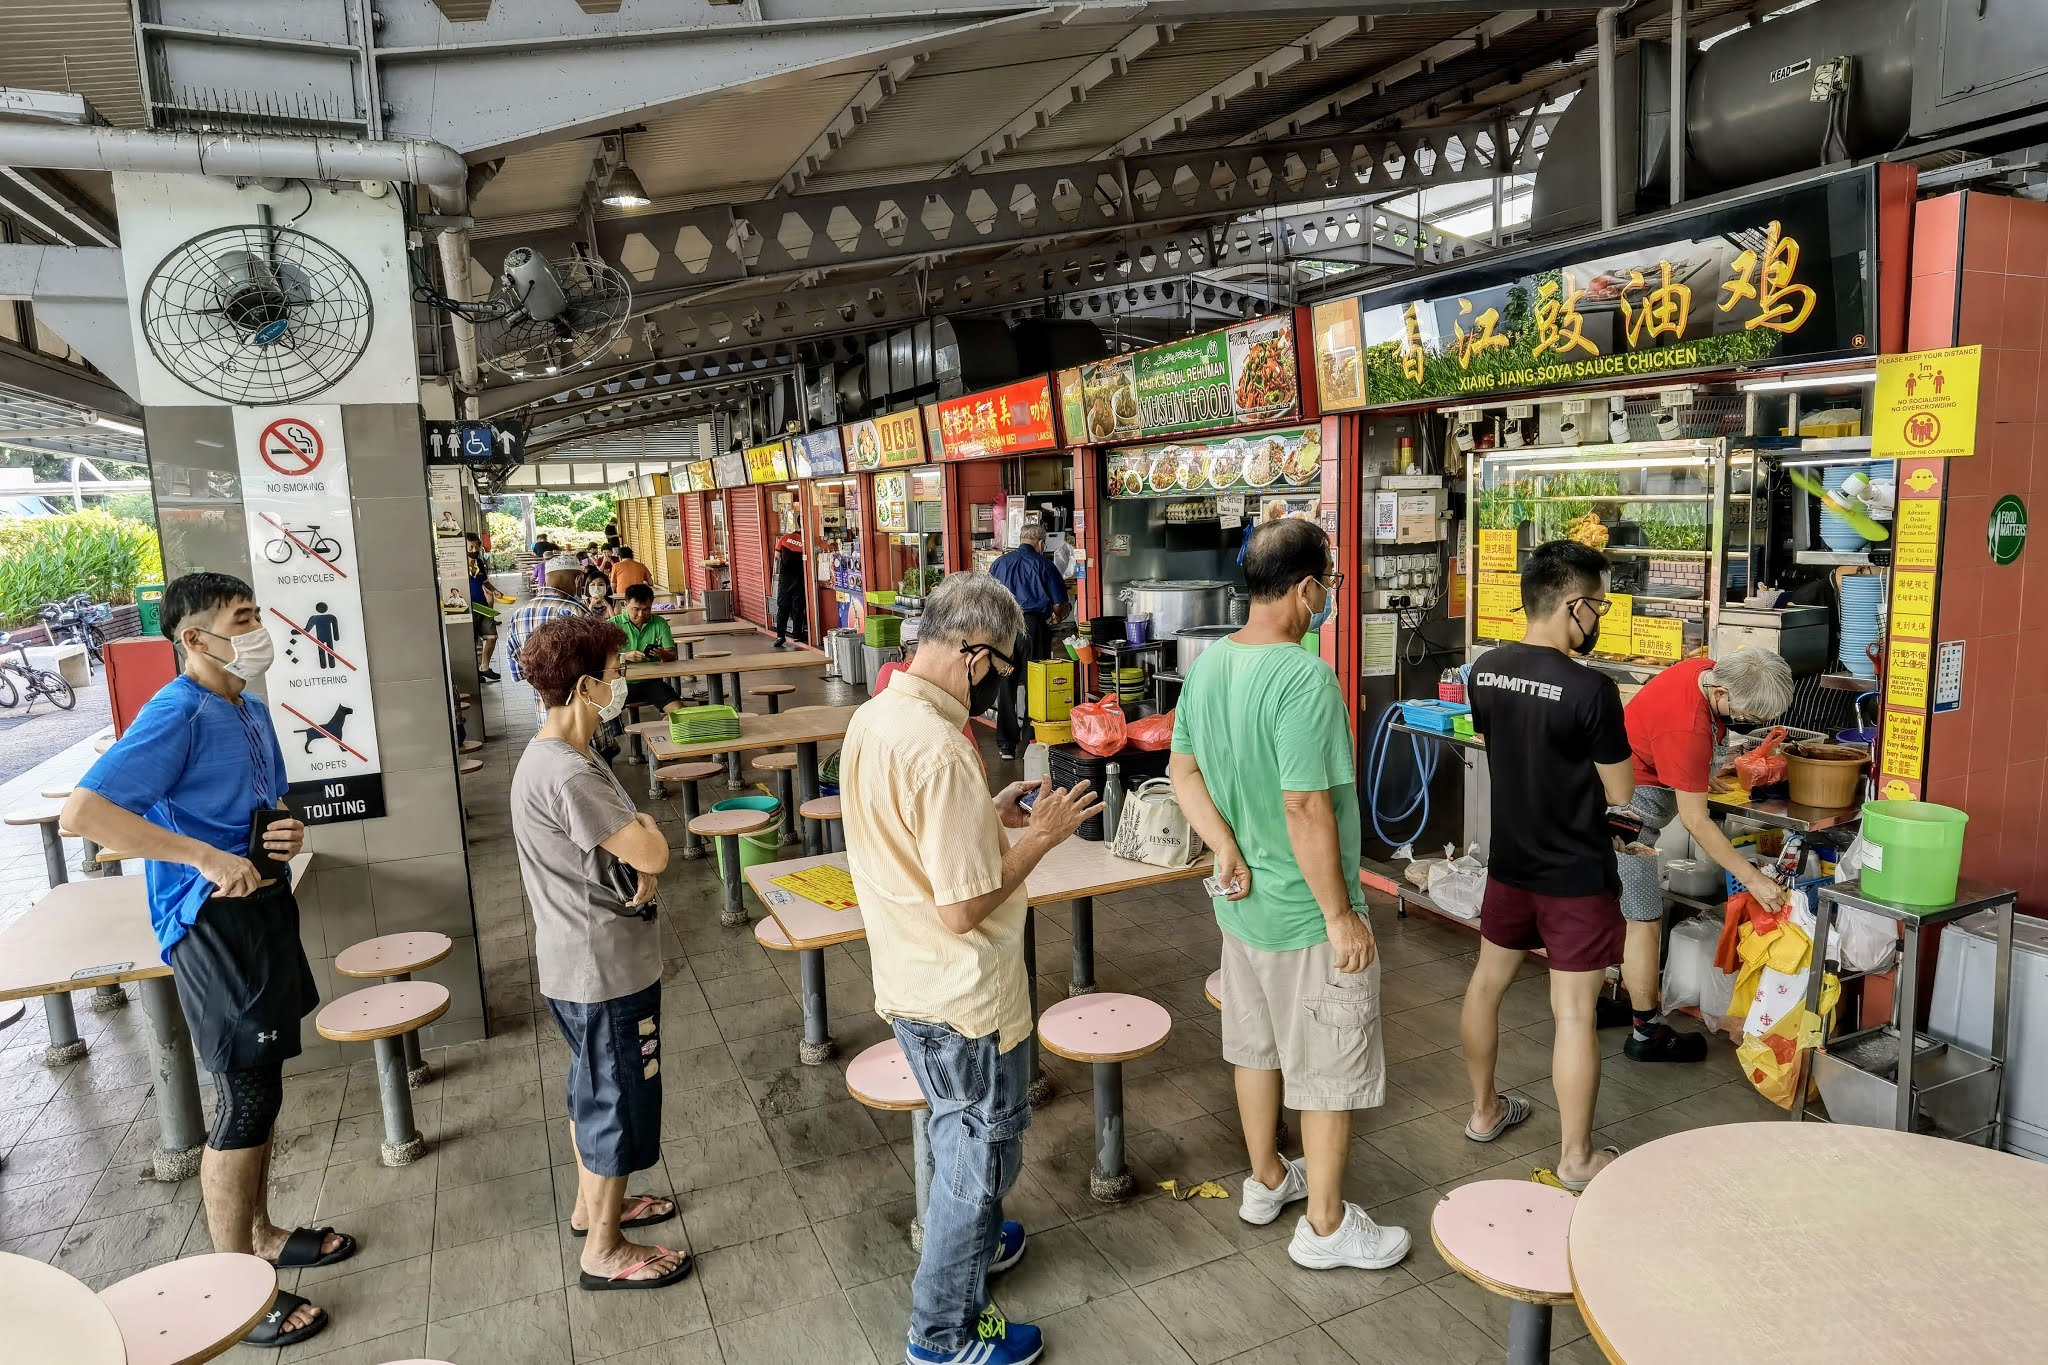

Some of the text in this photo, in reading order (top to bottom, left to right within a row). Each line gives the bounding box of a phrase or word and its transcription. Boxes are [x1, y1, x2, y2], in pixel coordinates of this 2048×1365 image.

[1878, 348, 1978, 364] PLEASE KEEP YOUR DISTANCE
[1458, 348, 1698, 392] XIANG JIANG SOYA SAUCE CHICKEN
[1918, 362, 1932, 371] 1m
[1160, 370, 1186, 387] ABDUL
[1187, 361, 1226, 382] REHUMAN
[1139, 383, 1232, 428] MUSLIM FOOD
[1908, 396, 1950, 404] SOCIALISING
[1902, 402, 1957, 412] OVERCROWDING
[1006, 434, 1017, 445] MEI
[267, 482, 325, 492] NO SMOKING
[2001, 511, 2017, 523] FOOD
[2000, 524, 2027, 536] MATTERS
[278, 574, 335, 584] NO BICYCLES
[1640, 639, 1672, 652] 自助服务
[1892, 649, 1927, 660] 行動不便
[1892, 659, 1927, 670] 人士優先
[289, 676, 348, 688] NO LITTERING
[1477, 672, 1563, 701] COMMITTEE
[1888, 714, 1922, 726] Our stall will
[1893, 724, 1918, 735] be closed
[1887, 740, 1919, 753] Every Monday
[1886, 749, 1918, 762] Every Tuesday
[310, 760, 347, 771] NO PETS
[324, 783, 345, 798] NO
[303, 800, 366, 820] TOUTING
[1149, 835, 1181, 846] HYSSES
